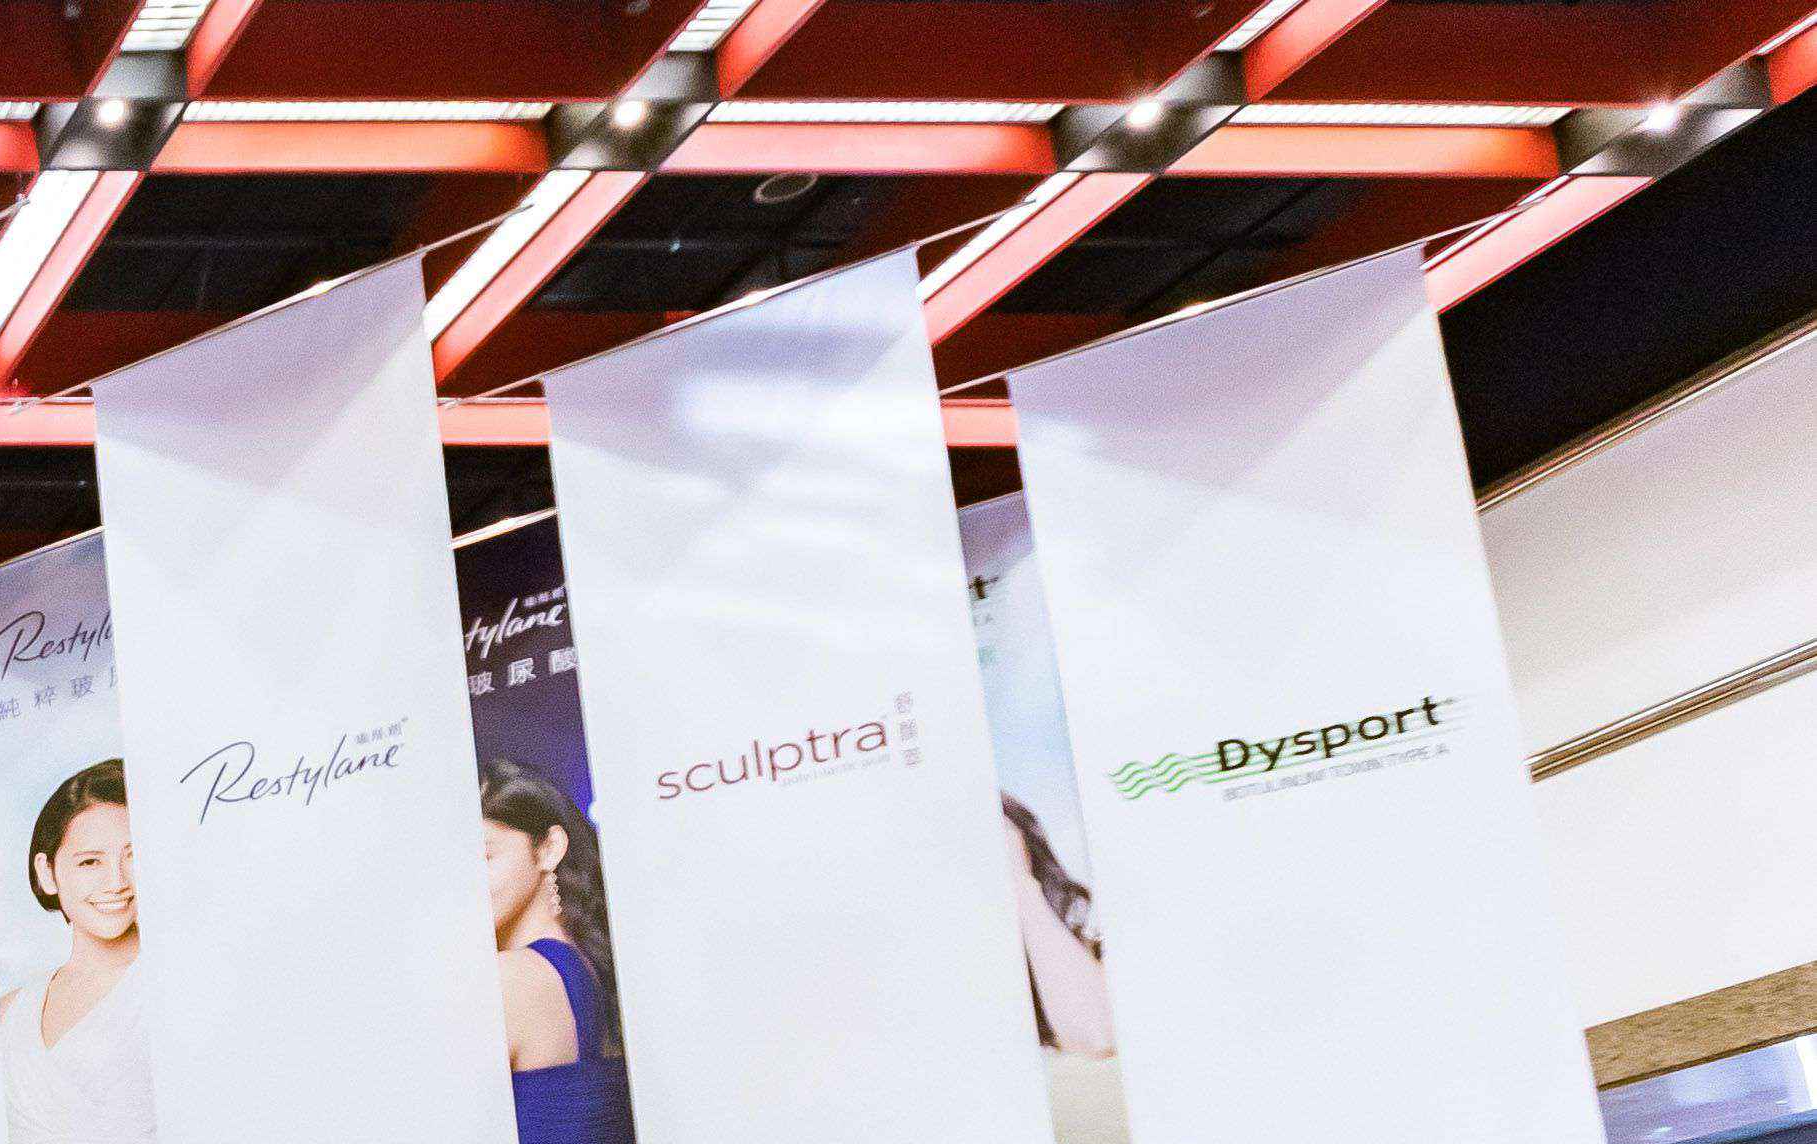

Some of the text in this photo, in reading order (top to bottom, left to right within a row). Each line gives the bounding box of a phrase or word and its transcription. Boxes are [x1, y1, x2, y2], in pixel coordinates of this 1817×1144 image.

[657, 720, 888, 801] sculptra
[1217, 695, 1440, 773] Dysport
[180, 732, 403, 825] Restylane
